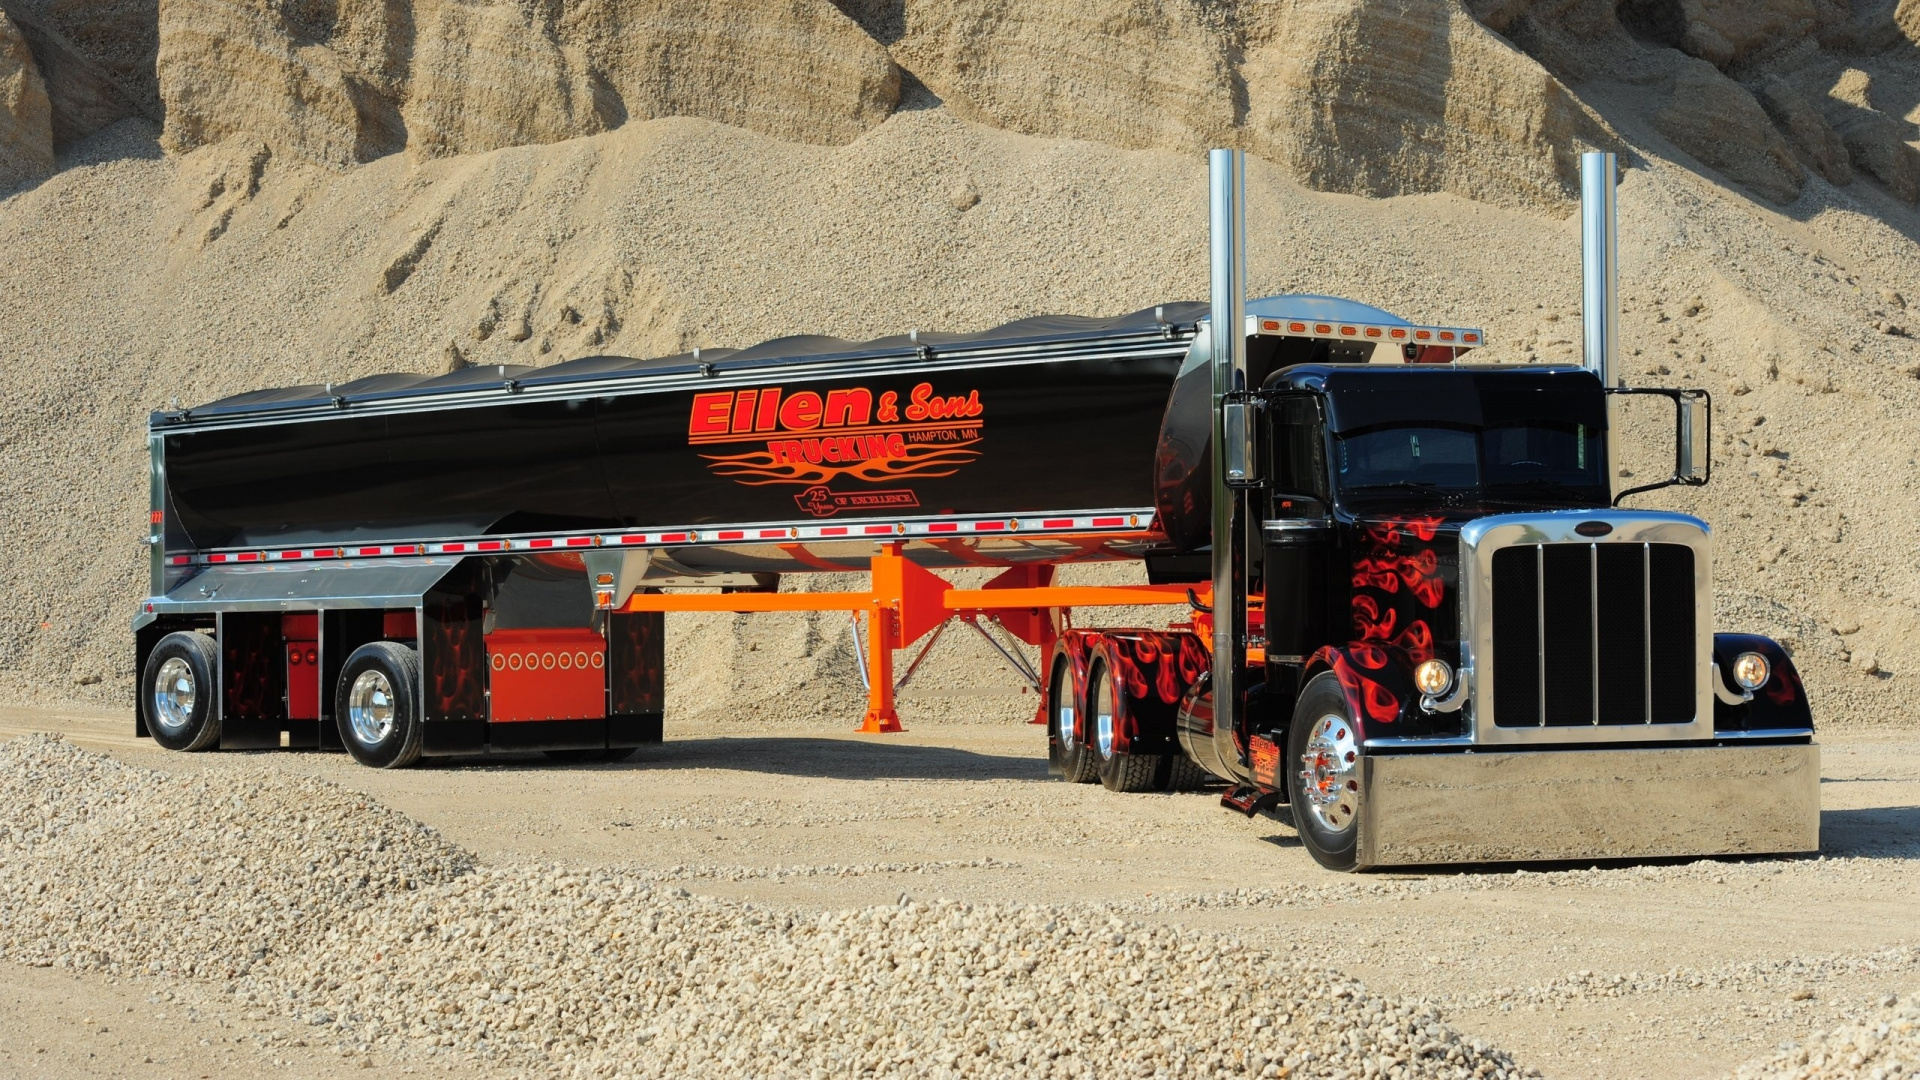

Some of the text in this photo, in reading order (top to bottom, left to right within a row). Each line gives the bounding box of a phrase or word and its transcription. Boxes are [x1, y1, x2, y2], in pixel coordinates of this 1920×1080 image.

[689, 383, 983, 433] Eilen & Sons
[908, 429, 978, 442] HAMPTON, MN
[767, 433, 907, 464] TRUCKING
[810, 490, 827, 501] 25
[835, 494, 913, 505] OF EXCELLENCE
[808, 502, 834, 513] Years
